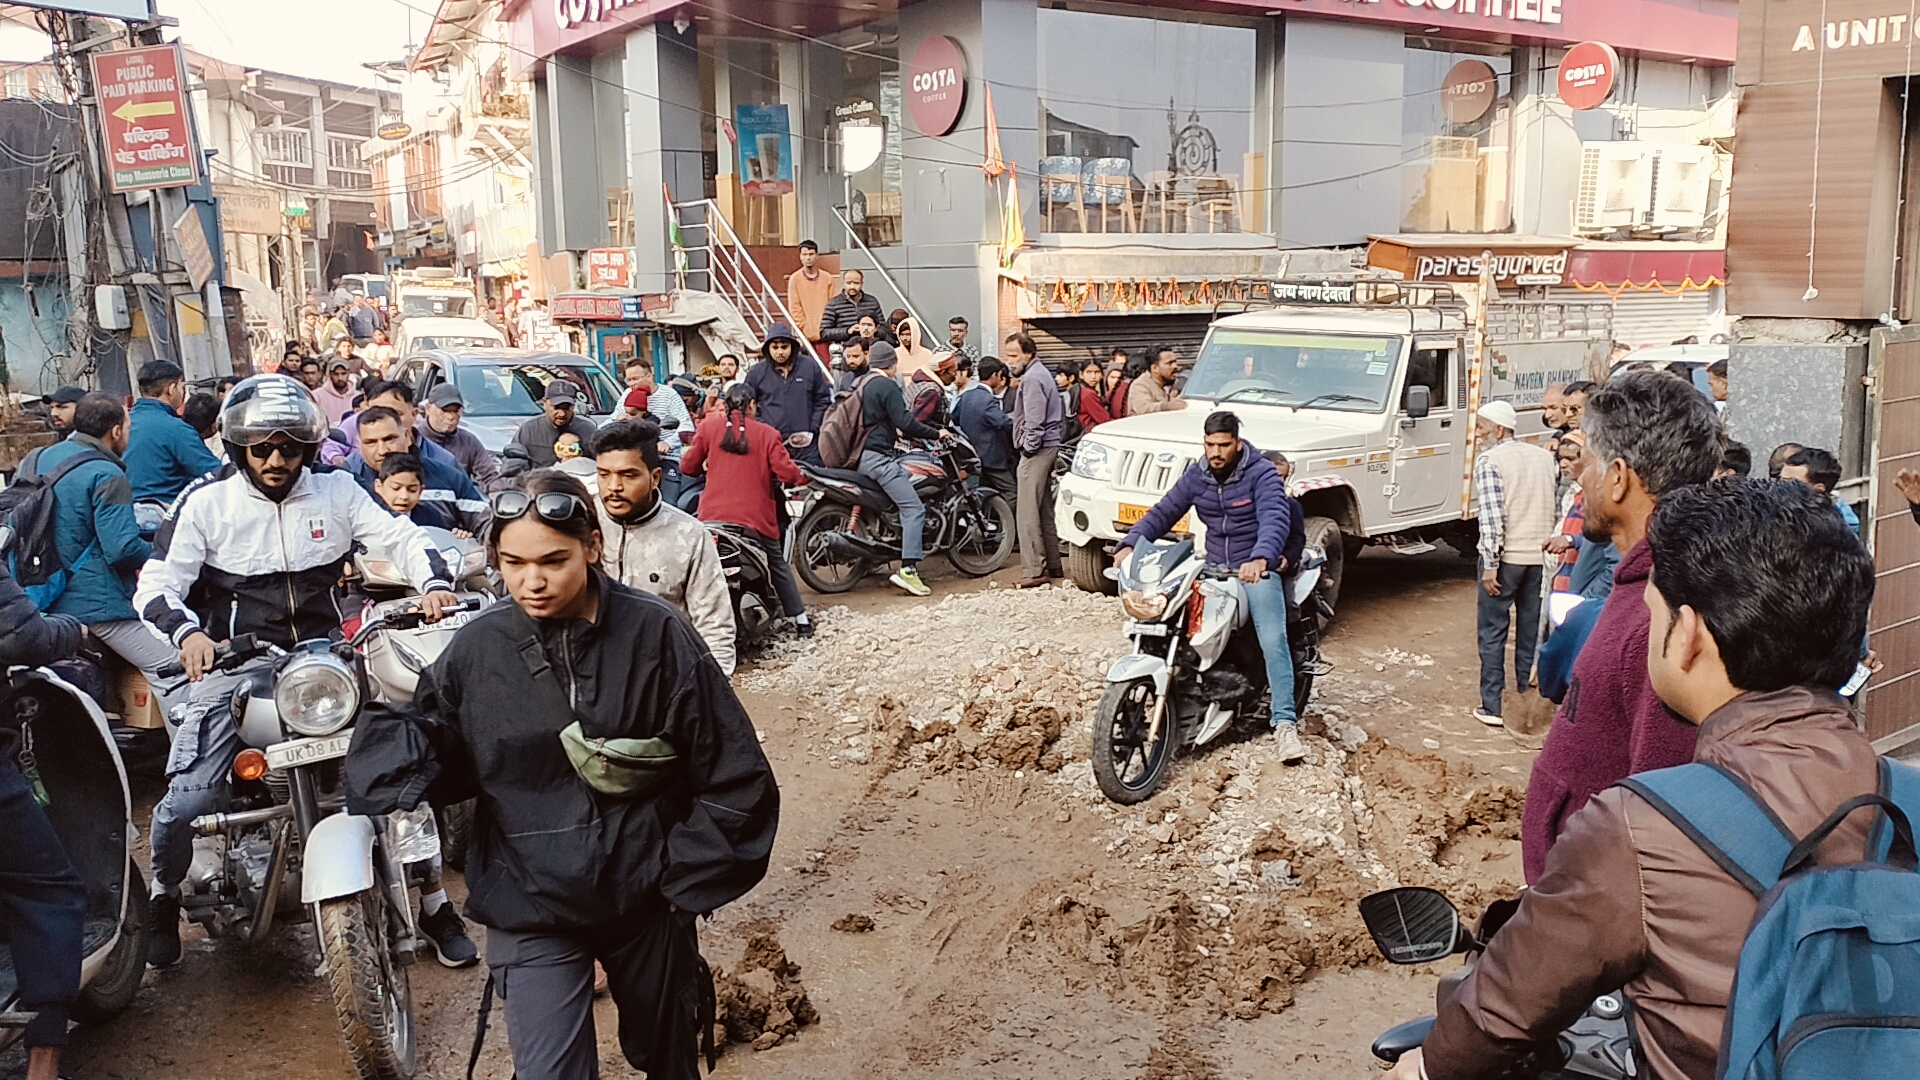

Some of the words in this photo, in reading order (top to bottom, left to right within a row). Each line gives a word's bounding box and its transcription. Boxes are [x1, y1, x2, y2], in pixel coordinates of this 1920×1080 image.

[1791, 25, 1815, 52] A
[1826, 14, 1907, 50] UNIT
[116, 64, 154, 82] PUBLIC
[913, 67, 956, 93] COSTA
[1564, 63, 1605, 82] COSTA
[102, 84, 126, 98] PAID
[128, 78, 175, 95] PARKING
[123, 126, 170, 144] पब्लिक
[115, 148, 136, 164] पेड
[1415, 256, 1482, 283] paras
[1490, 250, 1568, 281] ayurved
[1274, 284, 1298, 299] जय
[1125, 507, 1150, 520] UK0
[286, 749, 304, 762] UK
[307, 743, 325, 758] 08
[330, 739, 347, 753] AL
